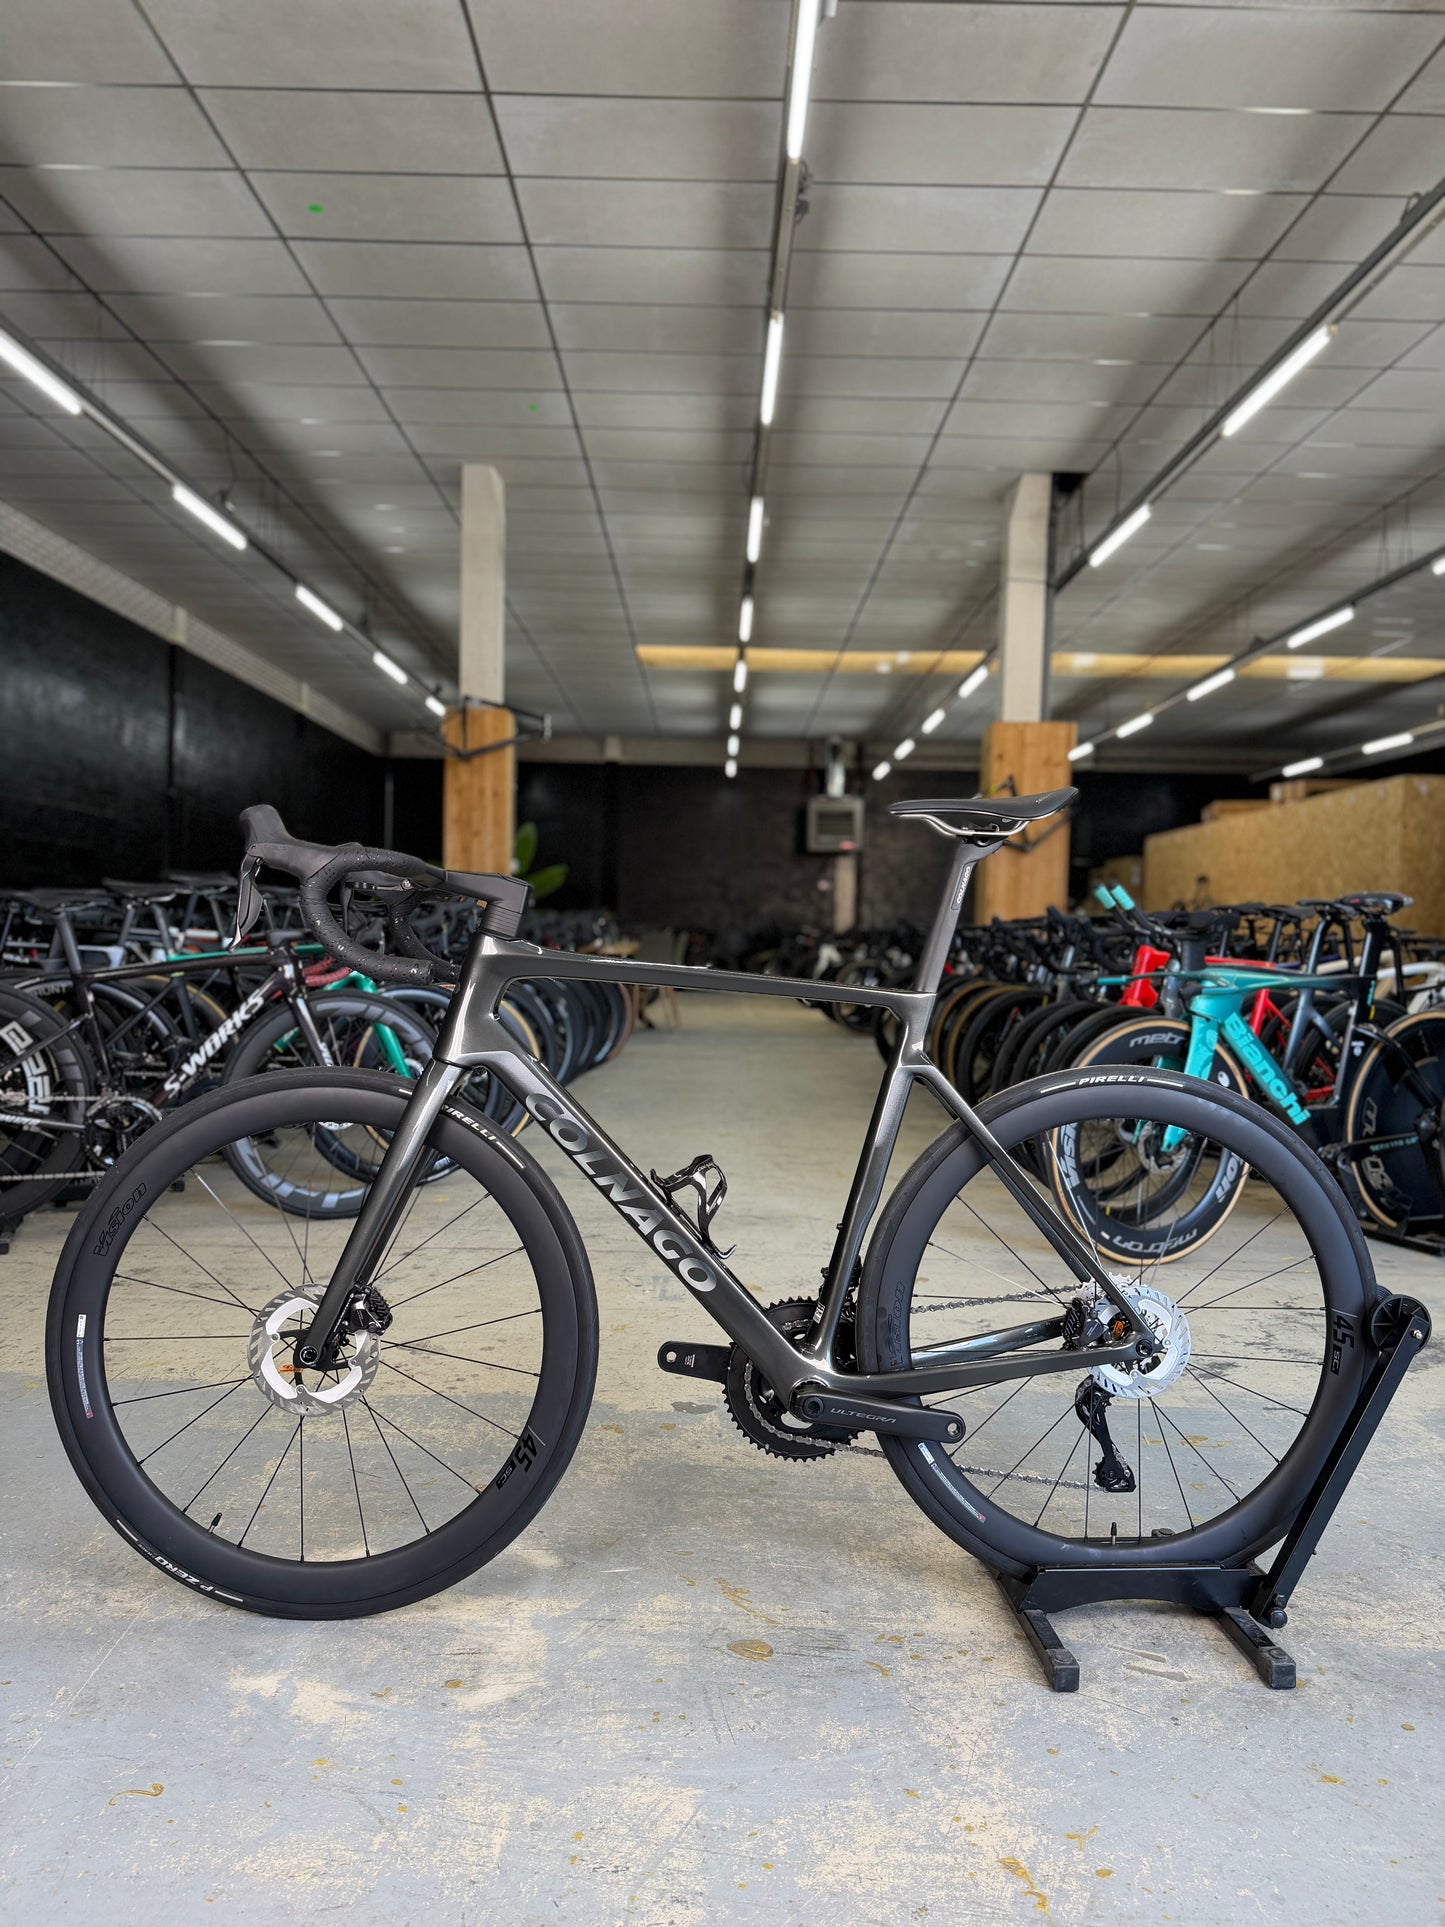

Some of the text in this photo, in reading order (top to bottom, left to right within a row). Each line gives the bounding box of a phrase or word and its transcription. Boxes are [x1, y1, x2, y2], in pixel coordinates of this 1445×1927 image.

[163, 989, 265, 1099] S-WORKS
[1129, 1032, 1187, 1048] metr
[1079, 1075, 1146, 1086] PIRELLI
[1224, 1012, 1311, 1125] Bianchi
[525, 1093, 717, 1292] COLNAGO
[1333, 1314, 1355, 1349] 45
[830, 1407, 897, 1424] ULTEGRA
[515, 1433, 537, 1473] 45
[154, 1555, 200, 1585] ZERO
[200, 1584, 215, 1592] P
